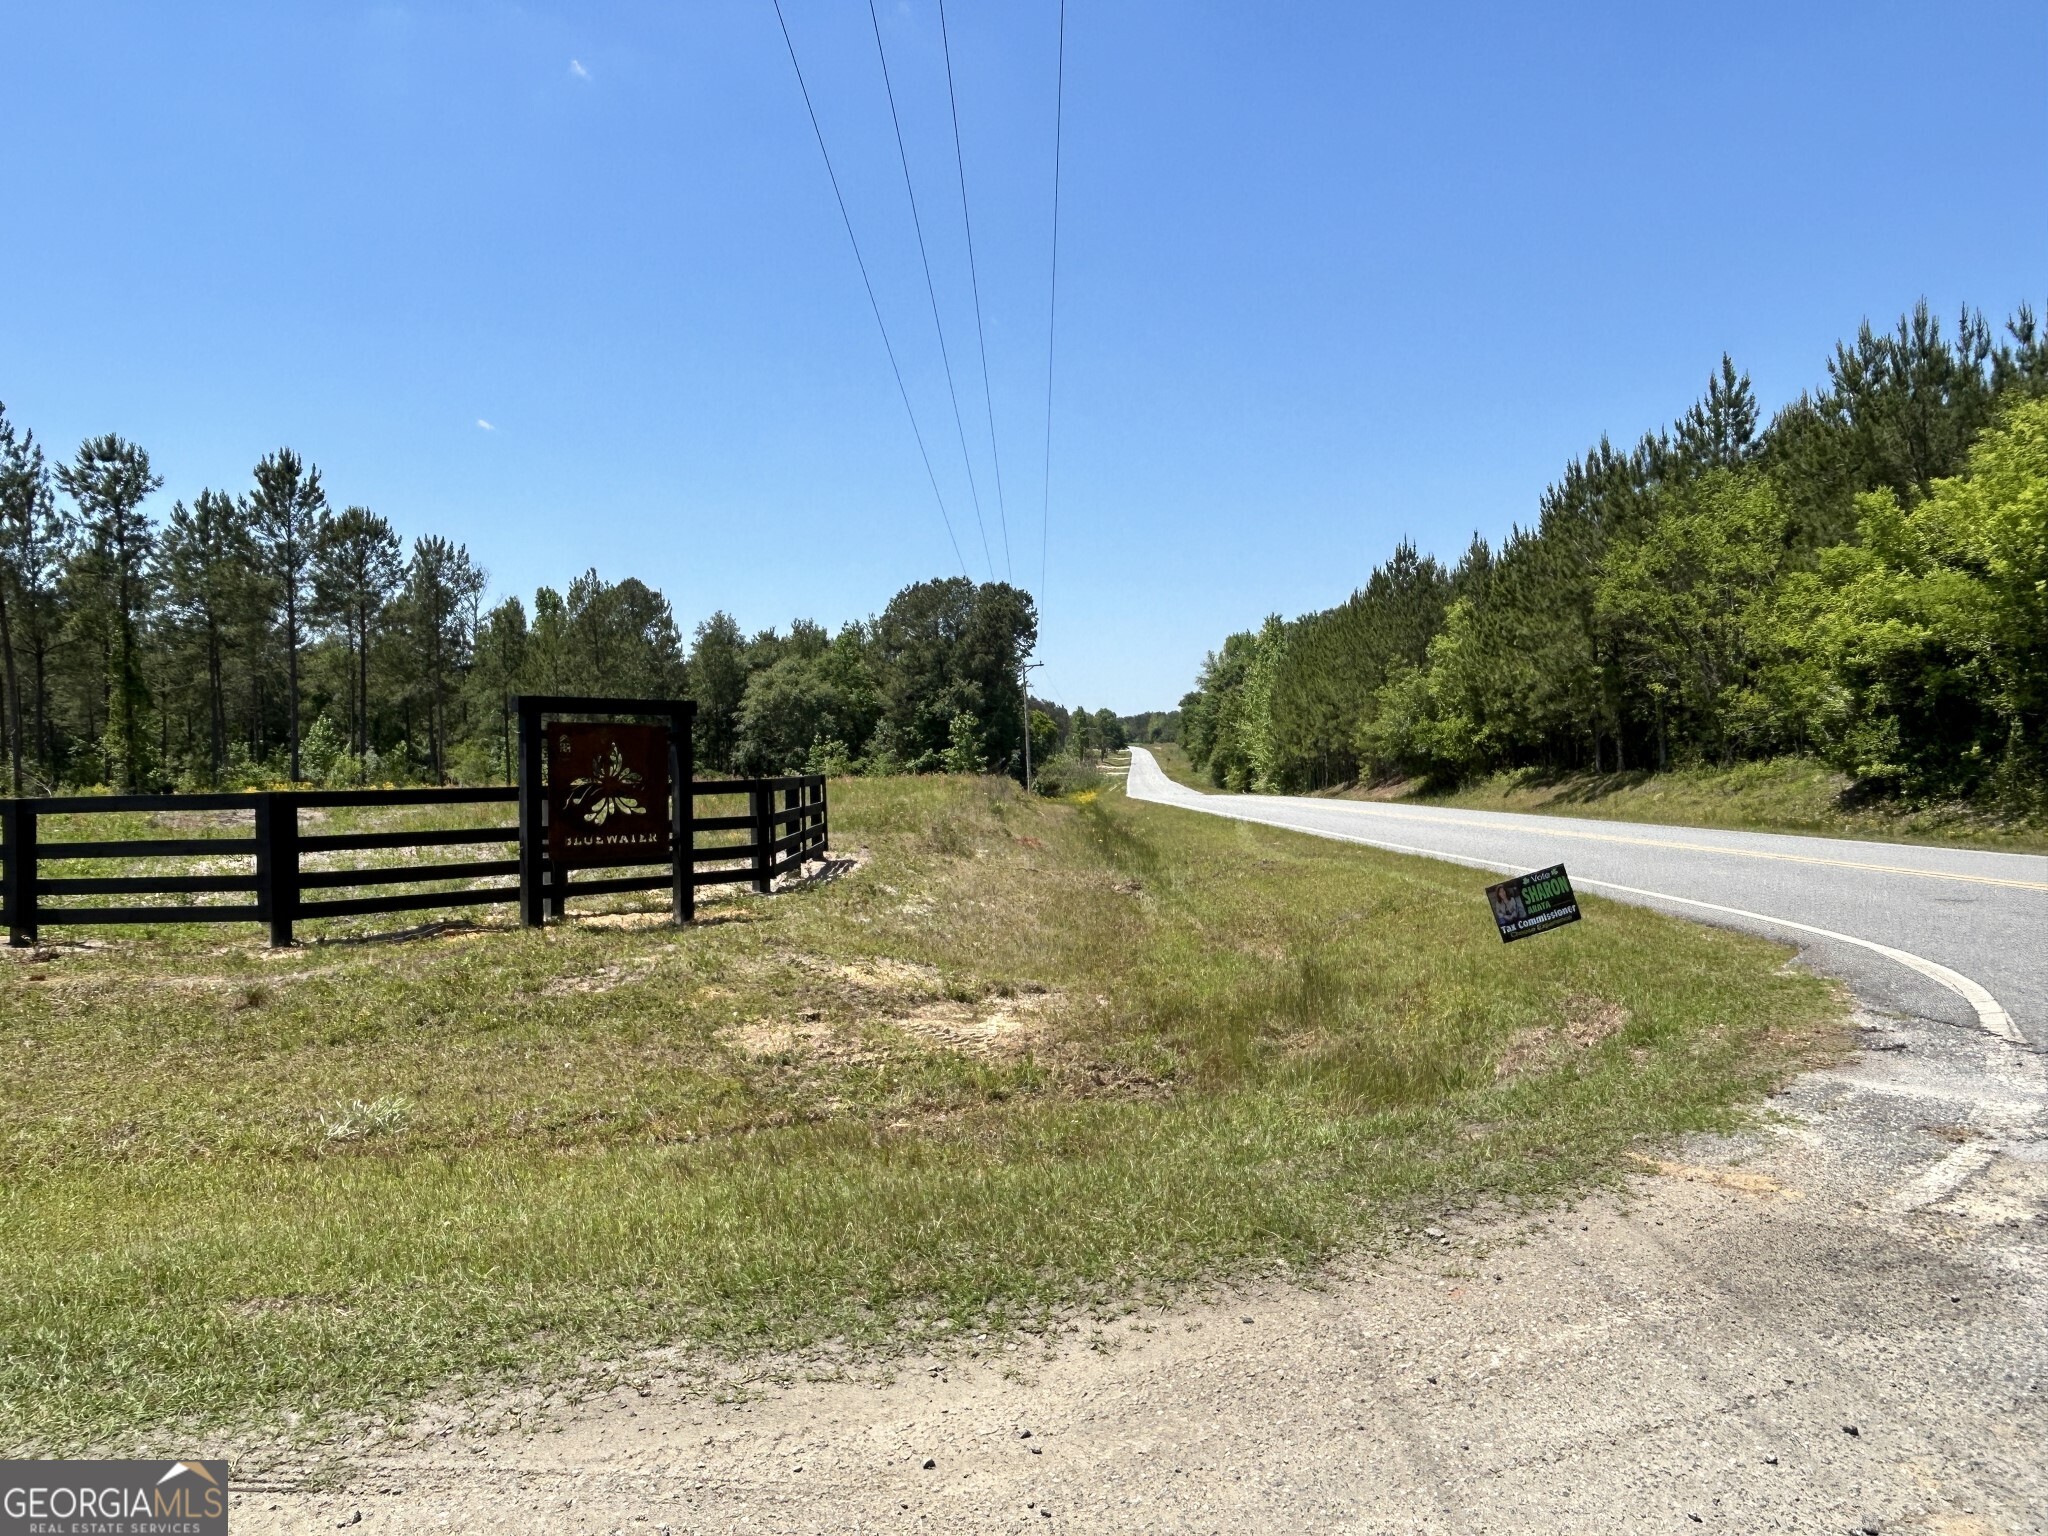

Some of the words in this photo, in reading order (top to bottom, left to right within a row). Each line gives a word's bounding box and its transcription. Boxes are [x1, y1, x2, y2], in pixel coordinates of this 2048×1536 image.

[1521, 876, 1570, 905] SHARON
[1531, 872, 1551, 882] Vote
[1501, 925, 1517, 934] Tax
[1518, 904, 1576, 928] Commissioner
